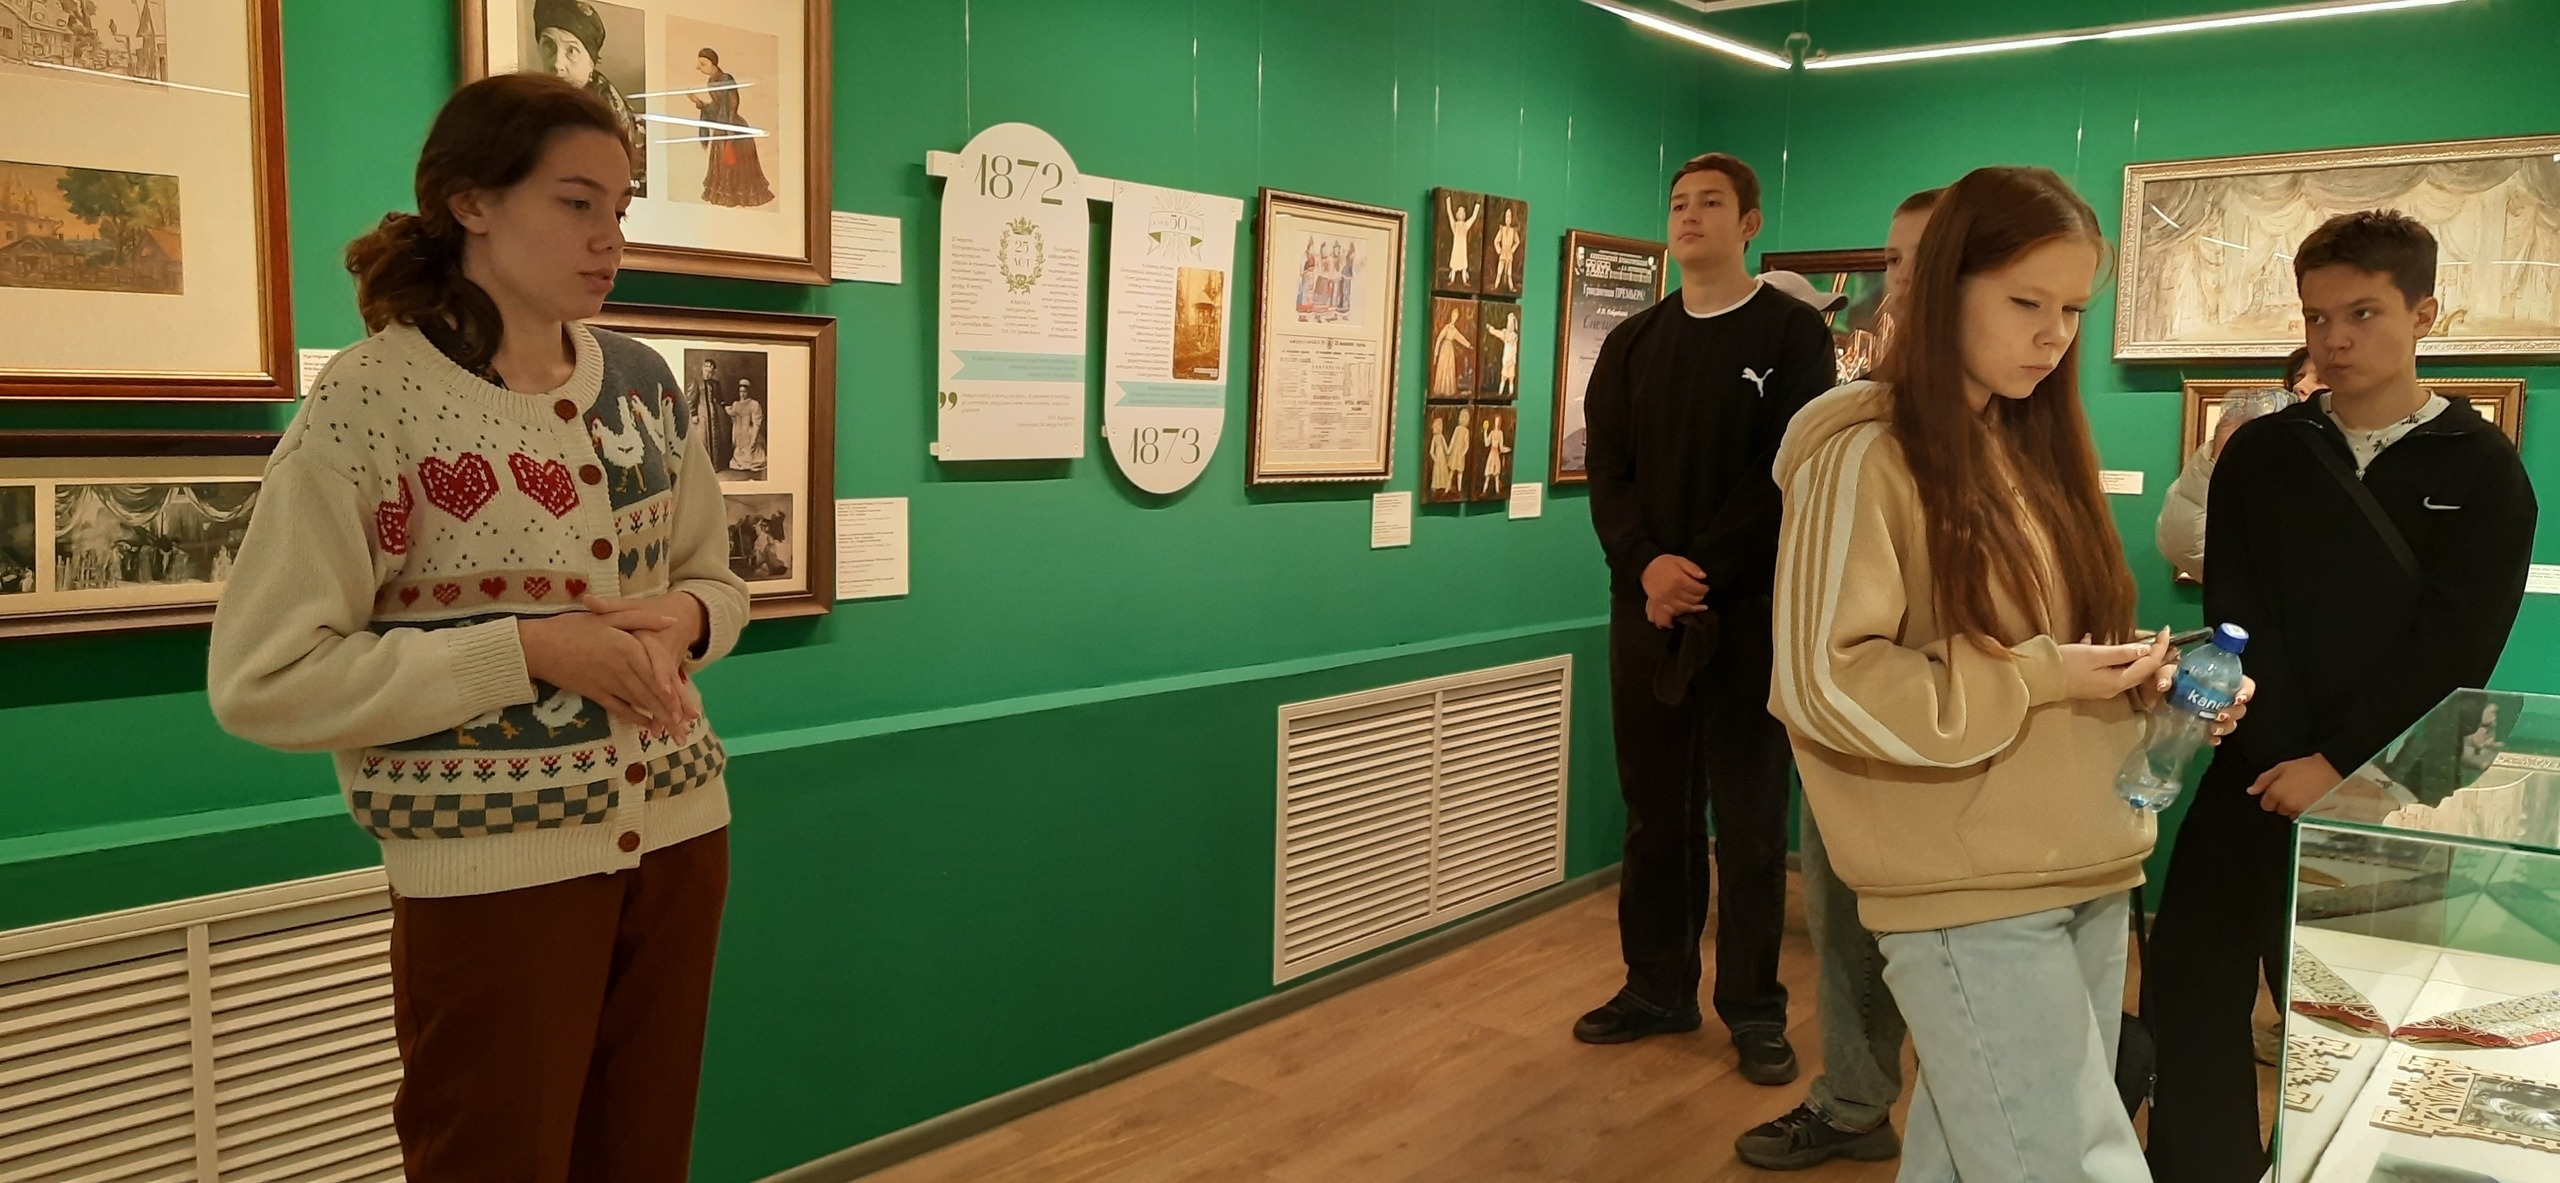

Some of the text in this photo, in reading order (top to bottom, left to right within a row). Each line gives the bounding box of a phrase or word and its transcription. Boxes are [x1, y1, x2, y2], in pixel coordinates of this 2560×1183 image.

[974, 154, 1063, 206] 1872
[1170, 214, 1188, 231] 50
[1014, 240, 1029, 254] 25
[1128, 427, 1200, 465] 1873
